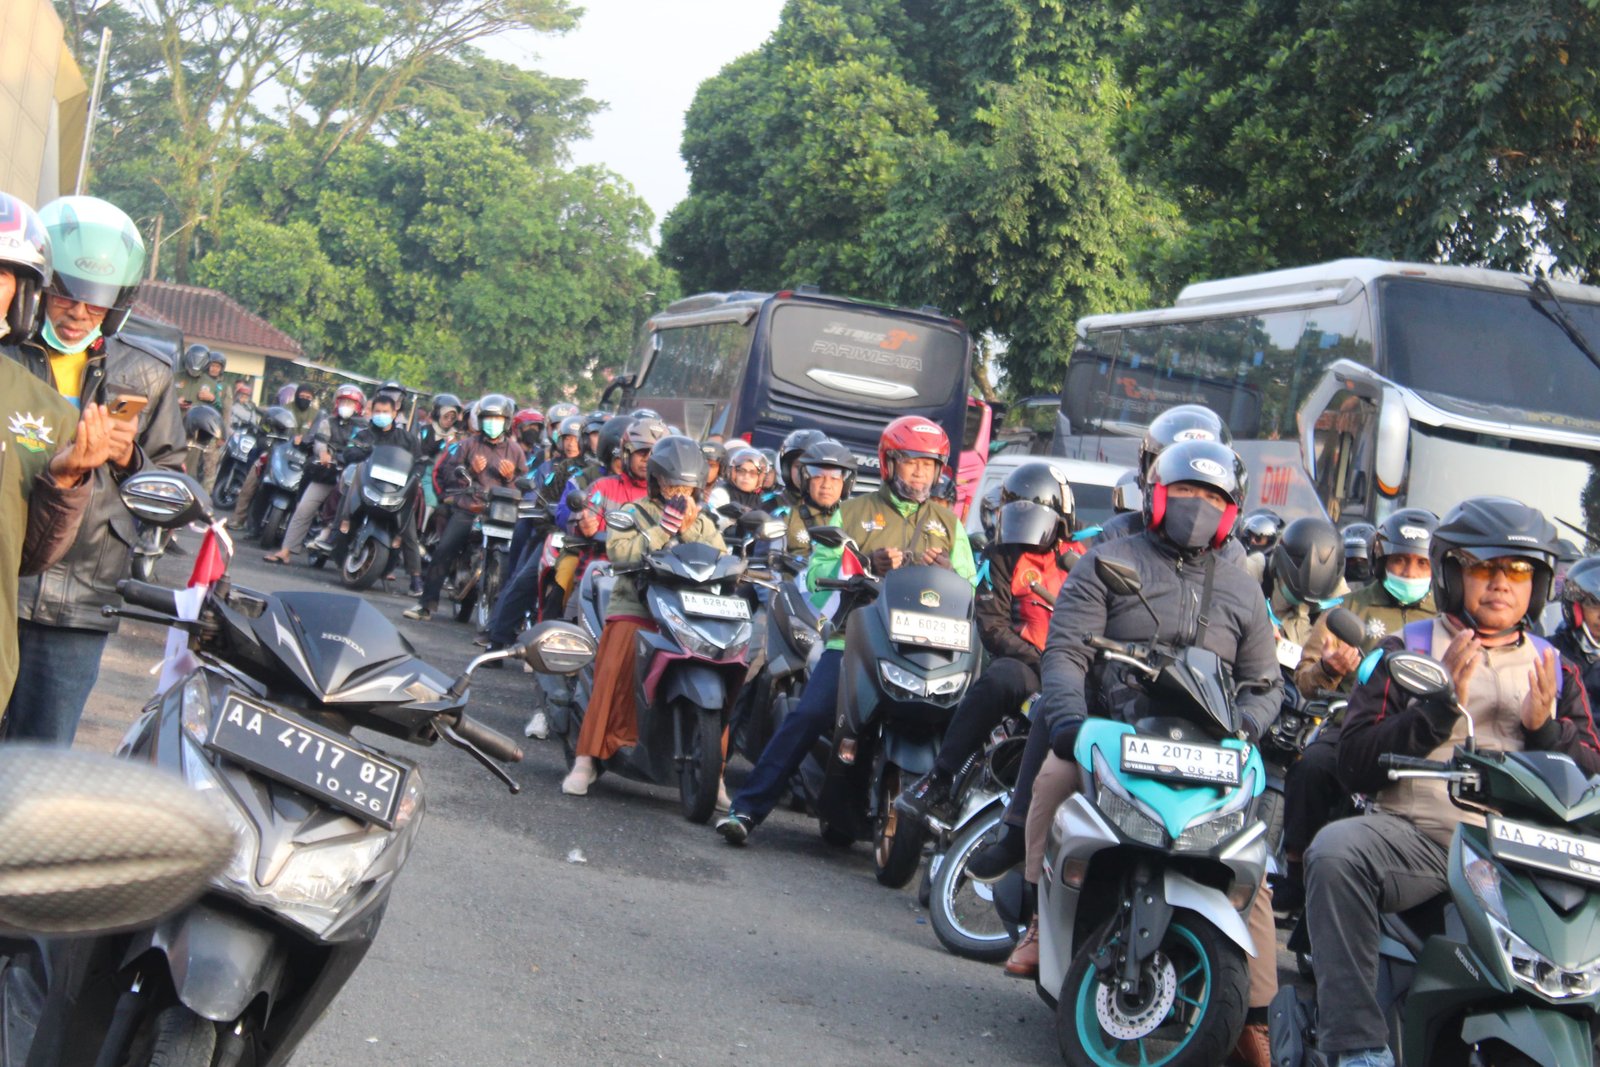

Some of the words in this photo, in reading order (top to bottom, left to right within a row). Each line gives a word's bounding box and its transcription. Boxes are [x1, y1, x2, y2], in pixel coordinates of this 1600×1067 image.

[811, 339, 922, 371] PARIWISATA
[320, 632, 366, 658] HONDA
[227, 704, 262, 735] AA
[277, 728, 346, 769] 4717
[1128, 741, 1150, 755] AA
[1162, 745, 1203, 761] 2073
[1215, 752, 1234, 766] TZ
[1131, 762, 1156, 772] YAMAHA
[1499, 824, 1525, 844] AA
[1536, 834, 1586, 858] 2378
[1454, 946, 1480, 982] HONDA
